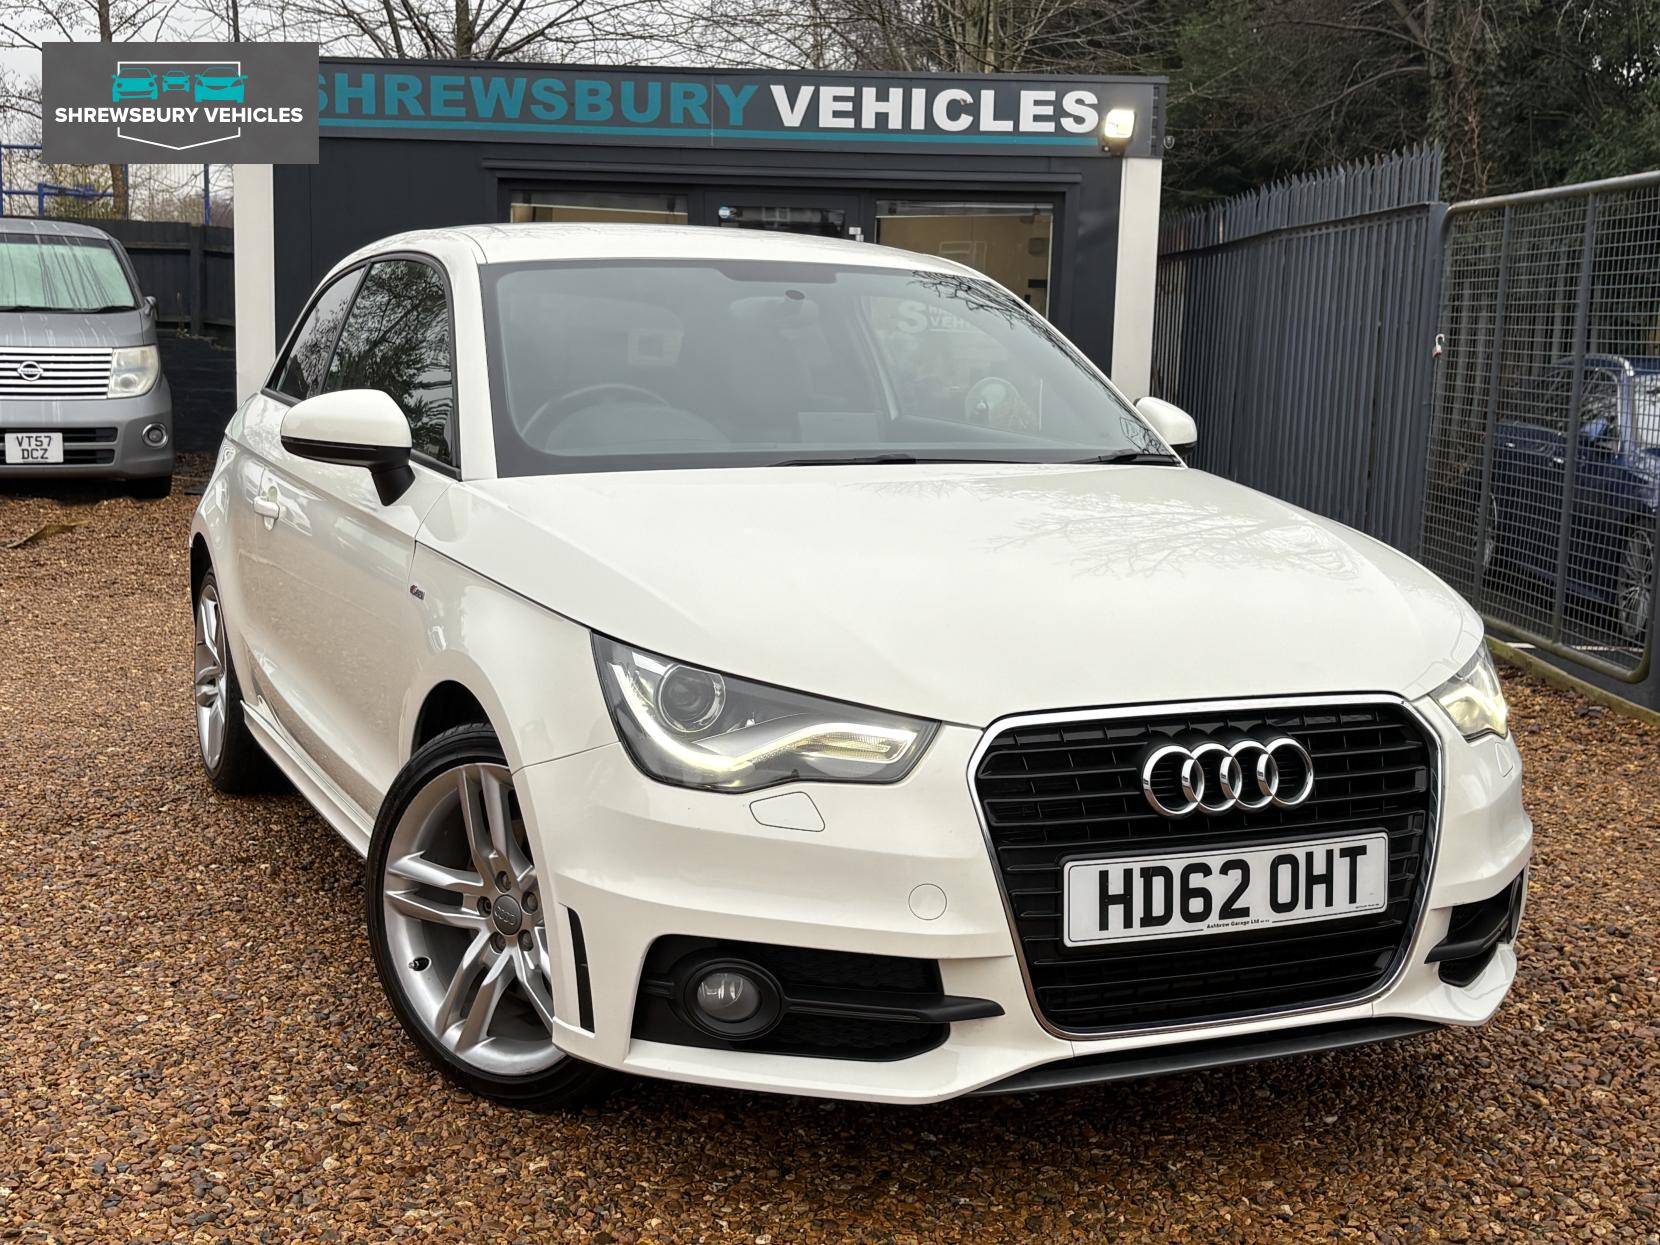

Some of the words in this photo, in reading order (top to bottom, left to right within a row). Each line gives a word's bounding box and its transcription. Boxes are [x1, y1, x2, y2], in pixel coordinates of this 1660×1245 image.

[319, 73, 758, 126] HREWSBURY
[770, 84, 1098, 133] VEHICLES
[16, 435, 52, 447] VT57
[21, 448, 48, 460] DCZ
[1099, 858, 1251, 931] HD62
[1270, 845, 1367, 914] OHT
